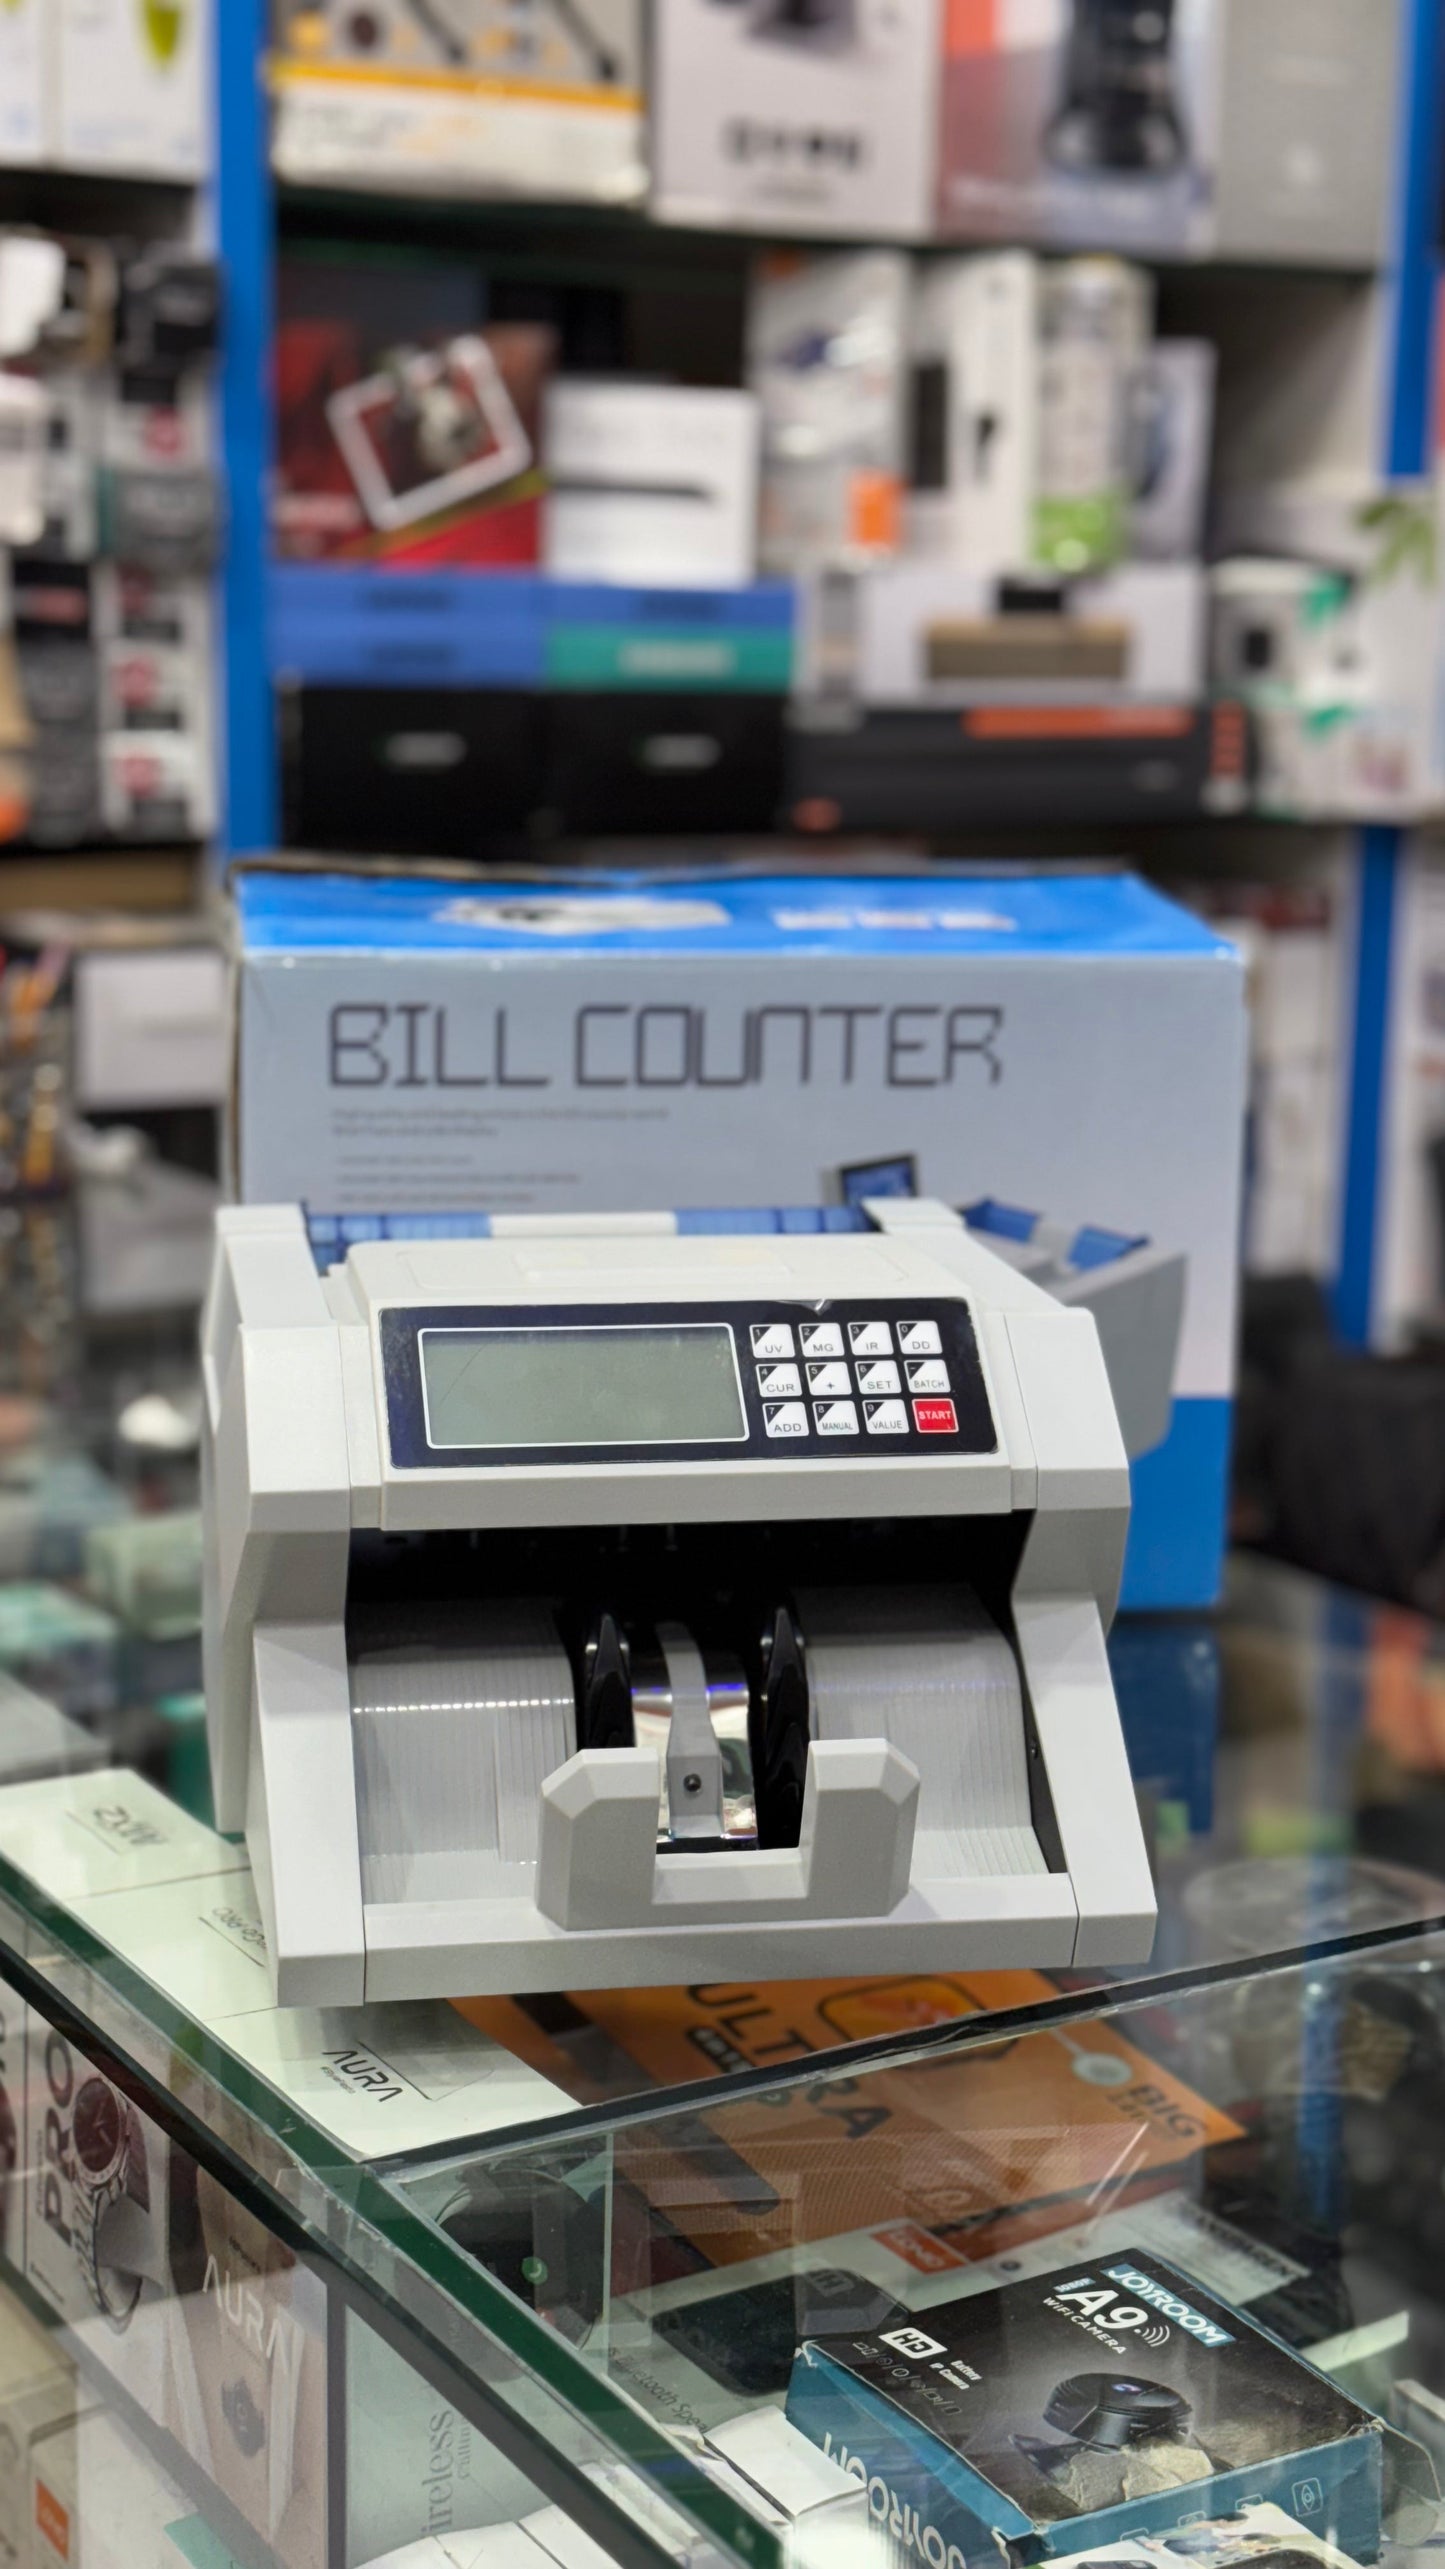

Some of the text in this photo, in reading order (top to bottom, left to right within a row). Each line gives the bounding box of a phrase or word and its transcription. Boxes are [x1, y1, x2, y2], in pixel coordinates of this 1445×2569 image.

[329, 1004, 1005, 1088] BILL COUNTER
[813, 1344, 834, 1352] MG
[866, 1342, 878, 1350] IR
[912, 1341, 930, 1349] DD
[766, 1384, 795, 1392] CUR
[867, 1380, 891, 1389] SET
[914, 1379, 945, 1388] BATCH
[918, 1410, 952, 1420] START
[774, 1424, 802, 1432] ADD
[822, 1422, 853, 1430] MANUAL
[872, 1420, 903, 1429] VALUE
[321, 2050, 403, 2102] AURA
[1055, 2289, 1149, 2329] A9
[1107, 2268, 1228, 2346] JOYROOM
[1070, 2315, 1128, 2355] CAMERA
[891, 2332, 934, 2354] HD
[420, 2409, 454, 2533] ireless
